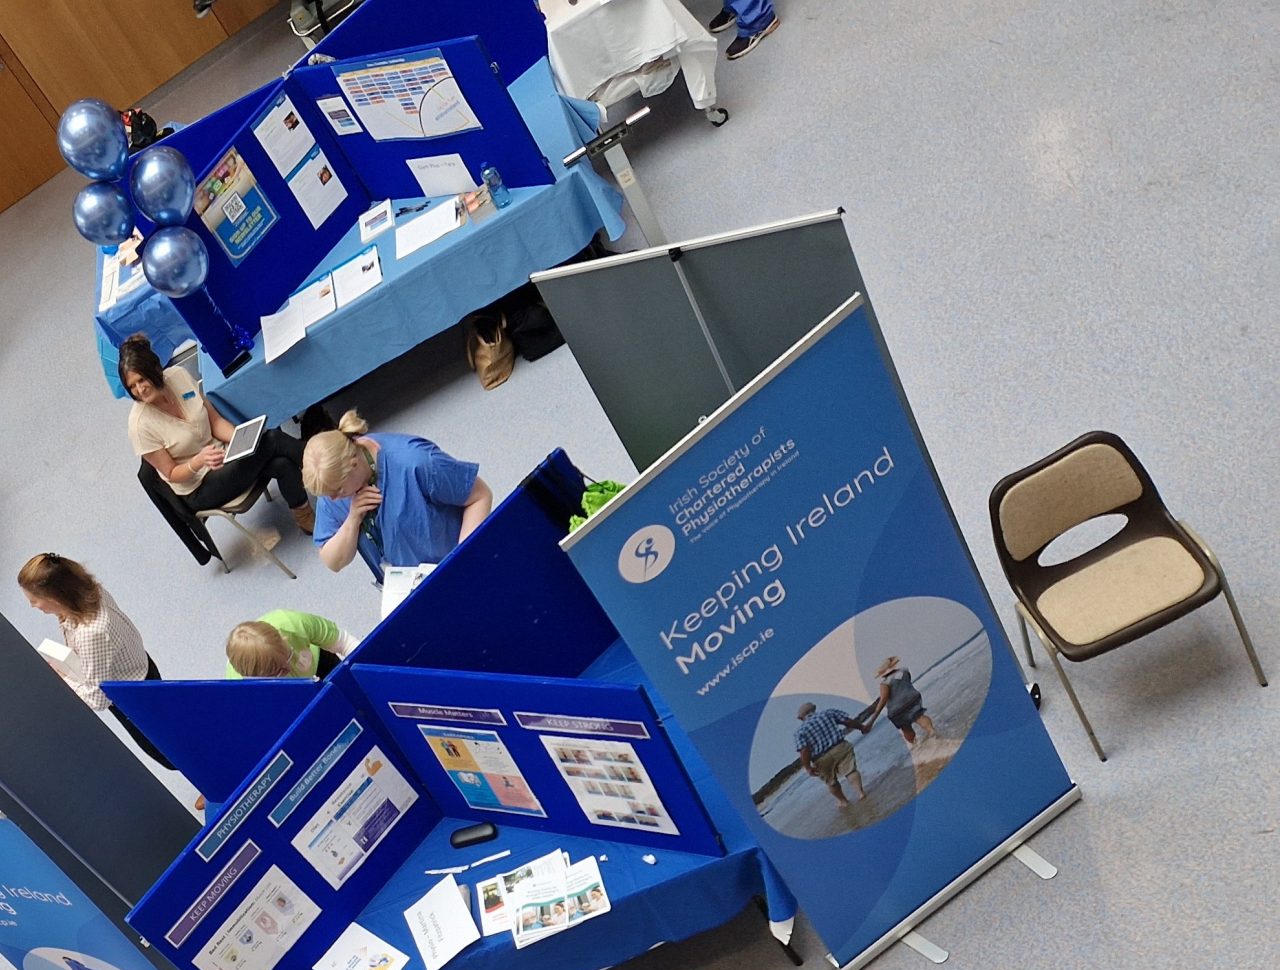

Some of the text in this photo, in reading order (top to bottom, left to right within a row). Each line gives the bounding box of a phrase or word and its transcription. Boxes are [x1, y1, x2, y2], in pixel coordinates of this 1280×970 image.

[668, 425, 768, 515] Irish Society of
[674, 462, 747, 525] Chartered
[681, 438, 795, 536] Physiotherapists
[659, 445, 895, 650] Keeping Ireland
[674, 578, 787, 675] Moving
[696, 626, 776, 697] www.iscp.ie
[546, 718, 614, 731] KEEP STRONG
[217, 774, 272, 839] PHYSIOTHERAPY
[289, 783, 306, 803] Build
[304, 761, 327, 787] Better
[4, 884, 72, 906] Ireland
[189, 866, 238, 922] KEEP MOVING
